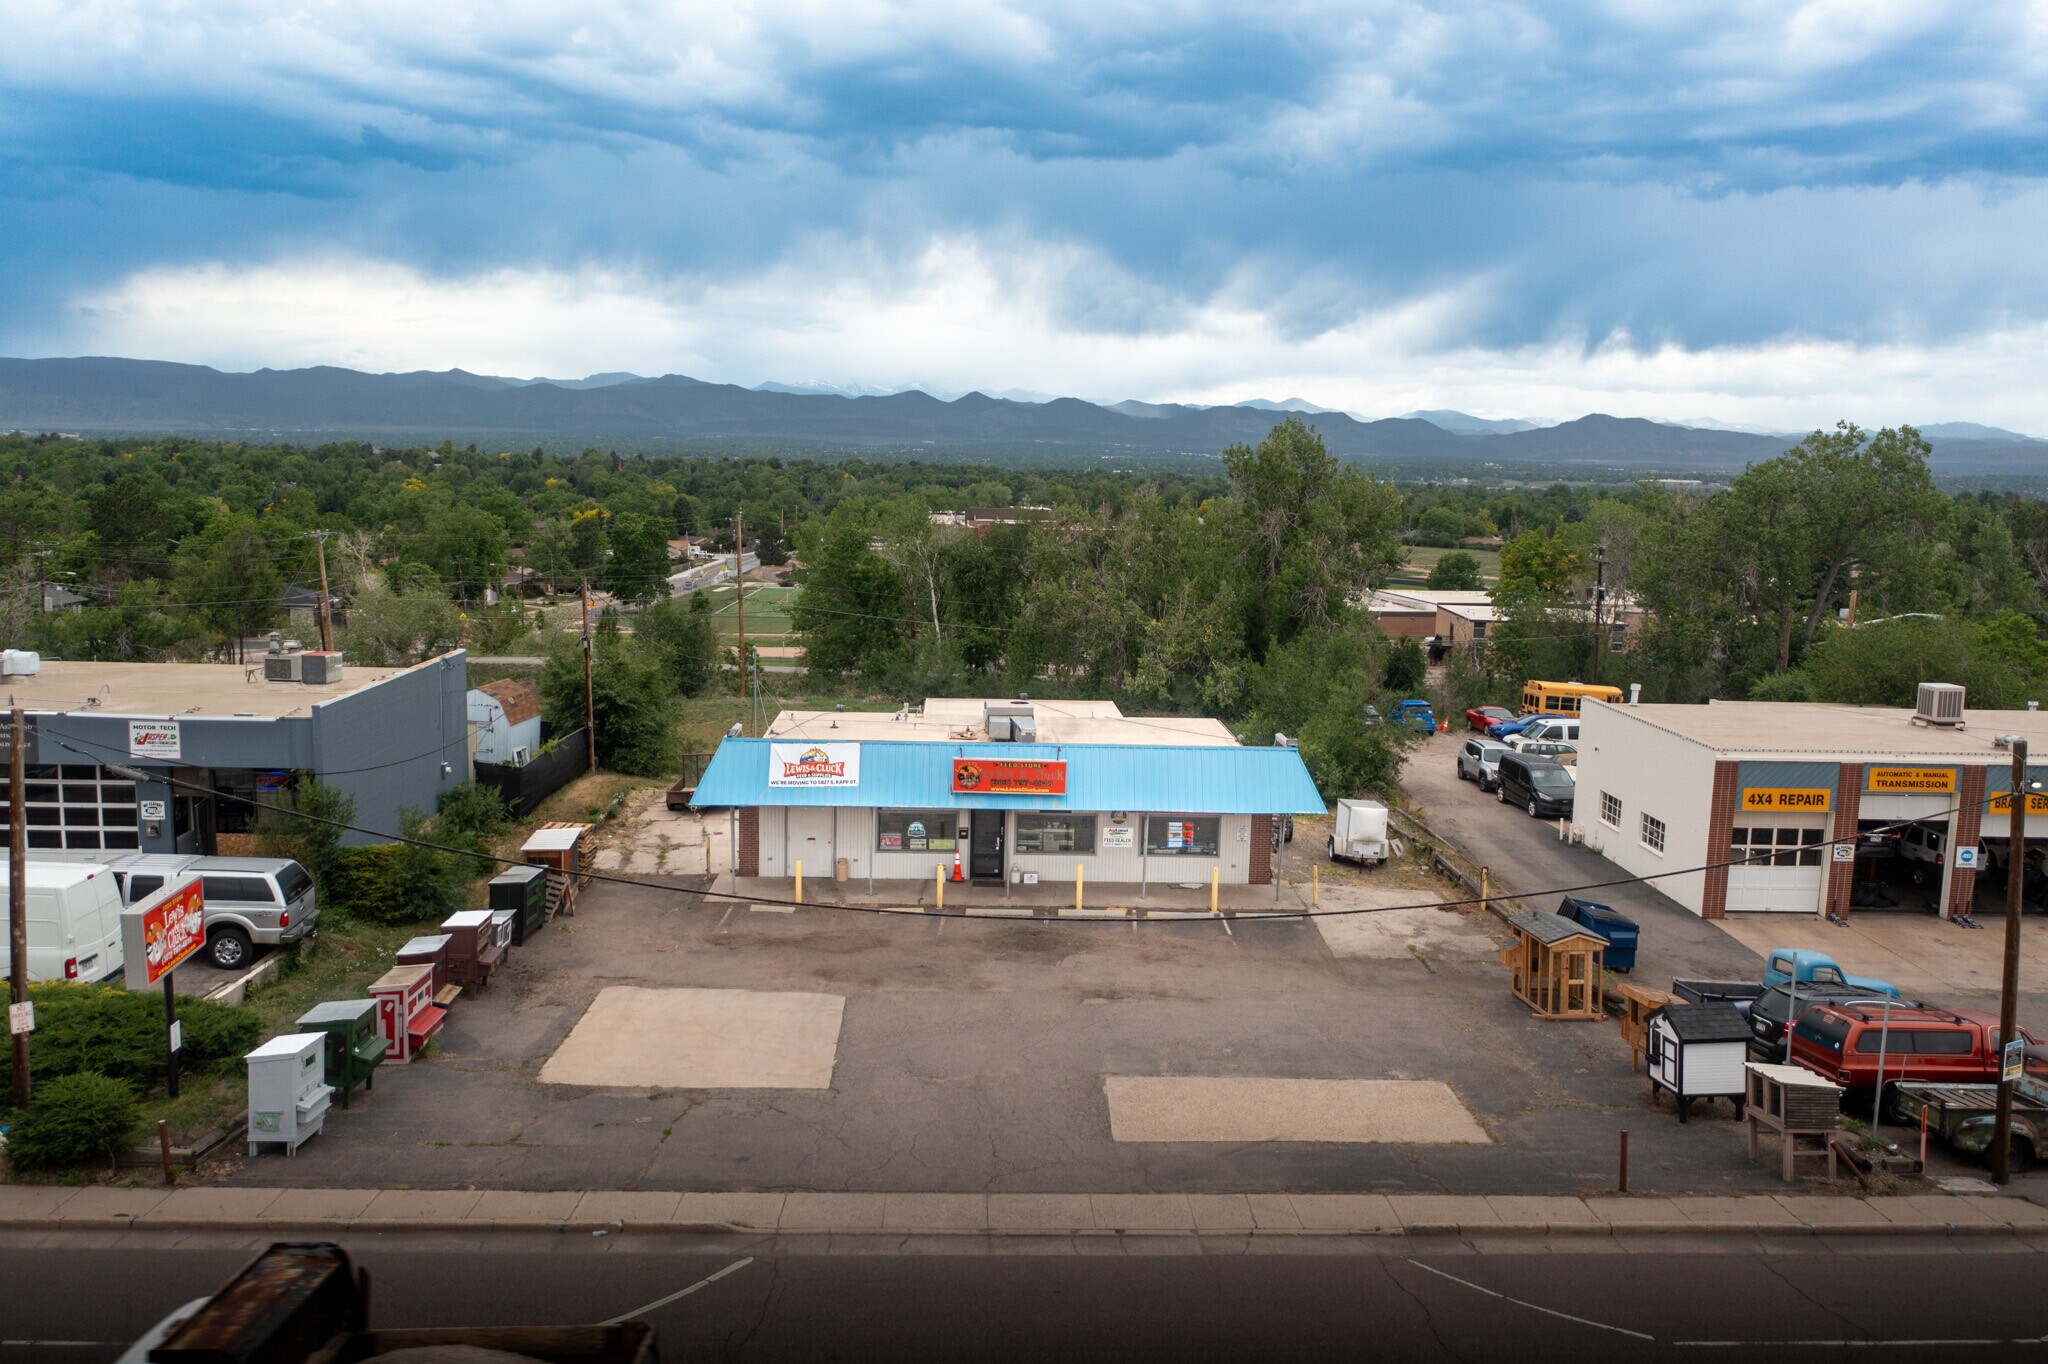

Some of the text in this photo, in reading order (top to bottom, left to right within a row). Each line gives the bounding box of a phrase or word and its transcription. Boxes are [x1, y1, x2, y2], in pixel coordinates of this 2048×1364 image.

[136, 732, 168, 745] JASPER
[786, 763, 810, 774] LEWIS
[816, 763, 842, 774] CLUCK
[983, 768, 1015, 779] Lewis
[1032, 768, 1064, 781] Cluck
[1876, 779, 1948, 788] TRANSMISSION
[1748, 793, 1825, 806] 4X4 REPAIR
[163, 904, 185, 928] Lewis
[11, 1010, 32, 1019] PARKING
